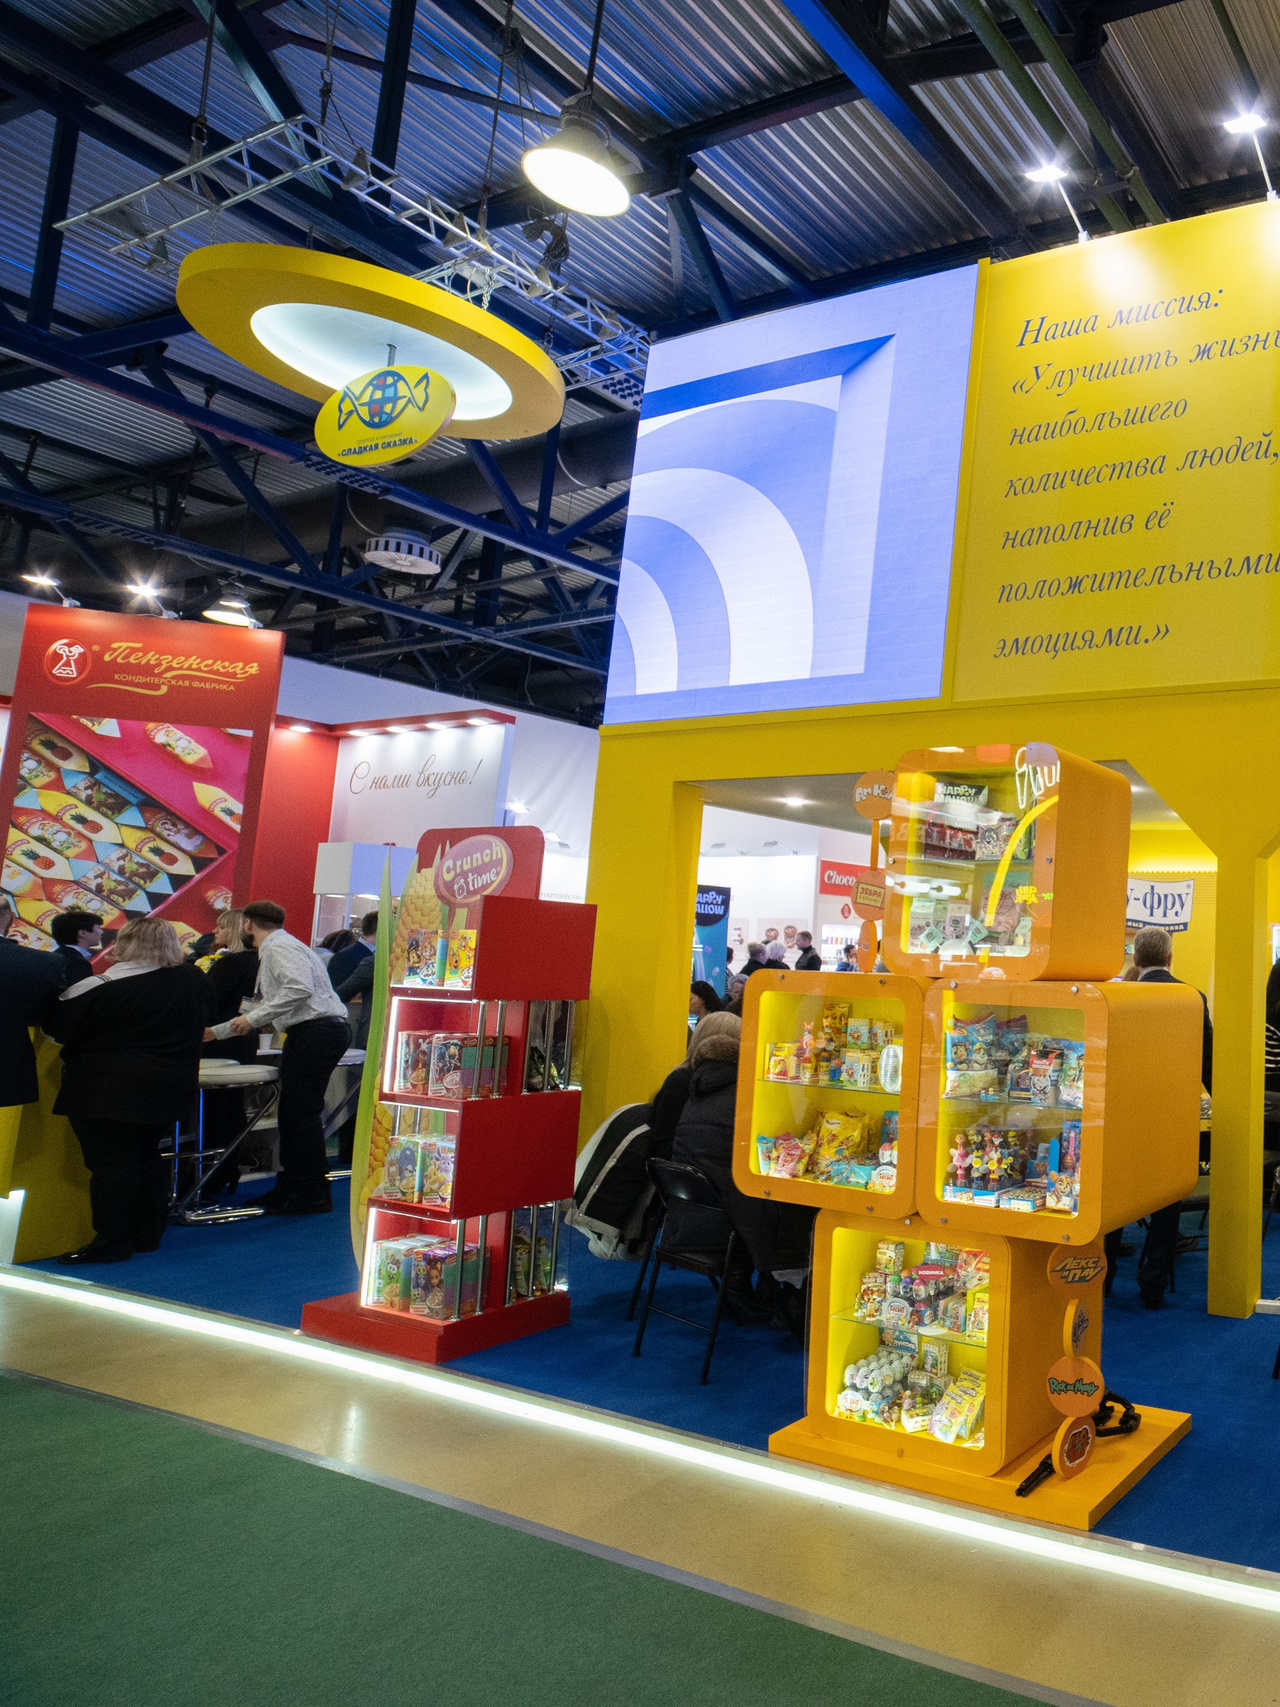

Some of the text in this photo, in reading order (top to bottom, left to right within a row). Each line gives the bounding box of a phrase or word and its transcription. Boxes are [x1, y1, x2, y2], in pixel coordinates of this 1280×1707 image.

[1015, 288, 1224, 348] Наша миссия:
[1011, 350, 1179, 396] «Улучшить
[1008, 398, 1188, 446] наибольшего
[1004, 430, 1280, 498] количества людей,
[1001, 502, 1175, 550] наполнив её
[103, 642, 259, 678] Пензенская
[993, 623, 1171, 660] эмоциями.»
[114, 673, 235, 691] КОНДИТЕРСКАЯ ФАБРИКА
[350, 754, 483, 799] С нами вкусно!
[443, 841, 503, 881] Crunch
[468, 868, 498, 891] time
[696, 891, 722, 904] APPY
[696, 903, 725, 915] ALLOW
[860, 887, 882, 898] ЗЕБРА
[1052, 1256, 1100, 1271] ЛЕКС
